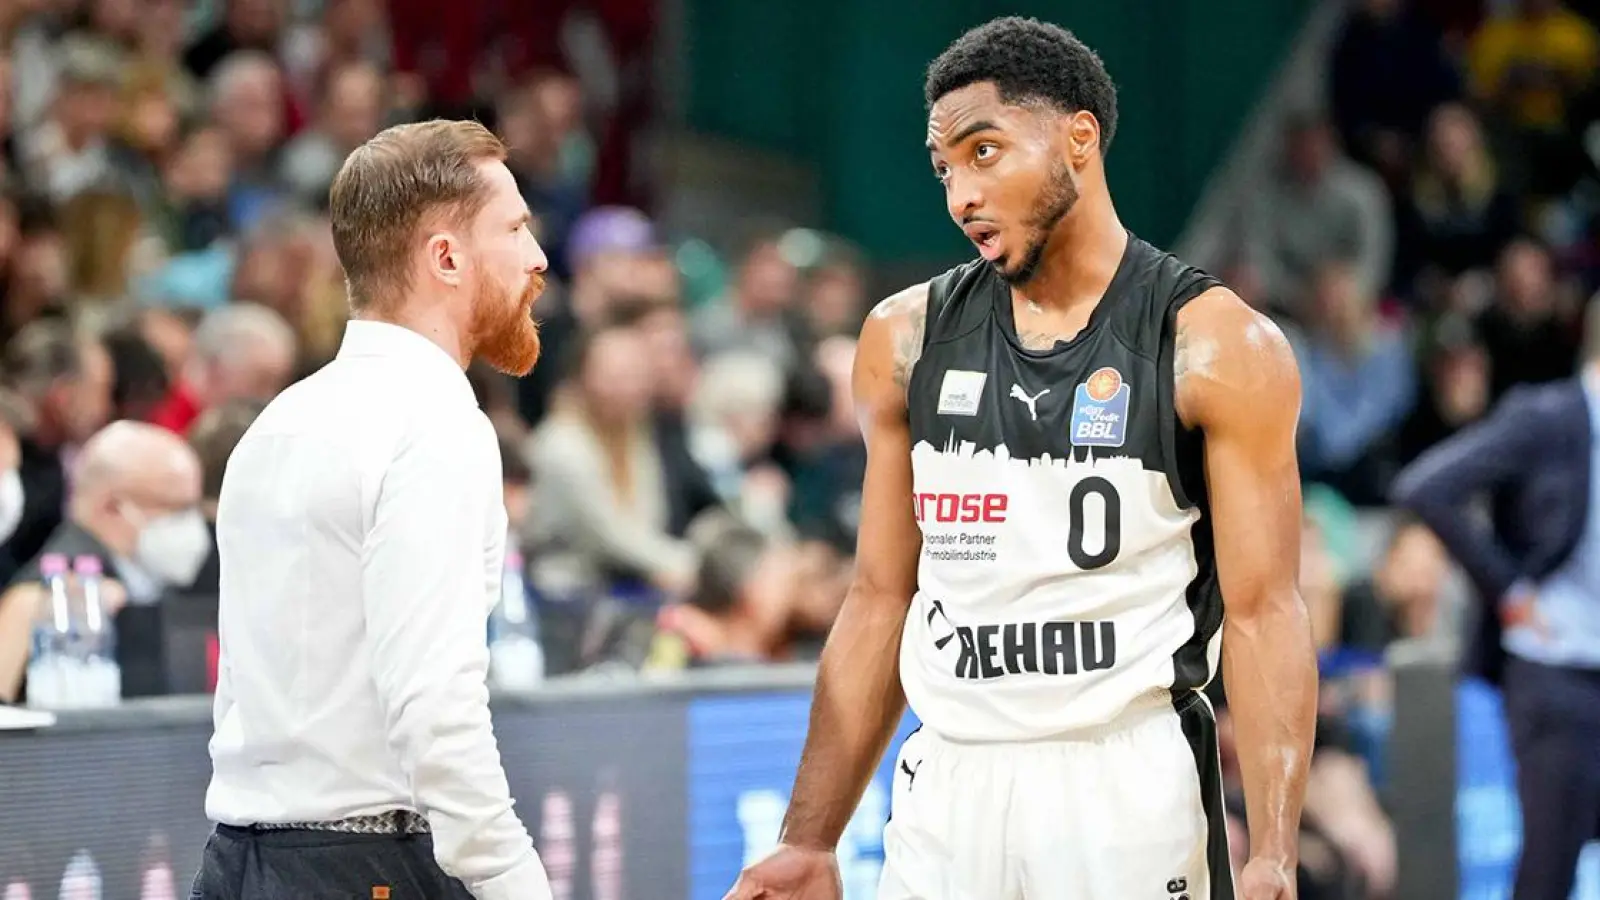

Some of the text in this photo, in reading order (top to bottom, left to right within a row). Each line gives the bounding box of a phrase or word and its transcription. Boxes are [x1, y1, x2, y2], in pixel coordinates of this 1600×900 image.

[1076, 422, 1117, 438] BBL
[960, 532, 996, 545] Partner
[1068, 476, 1120, 570] 0
[955, 621, 1116, 679] REHAU
